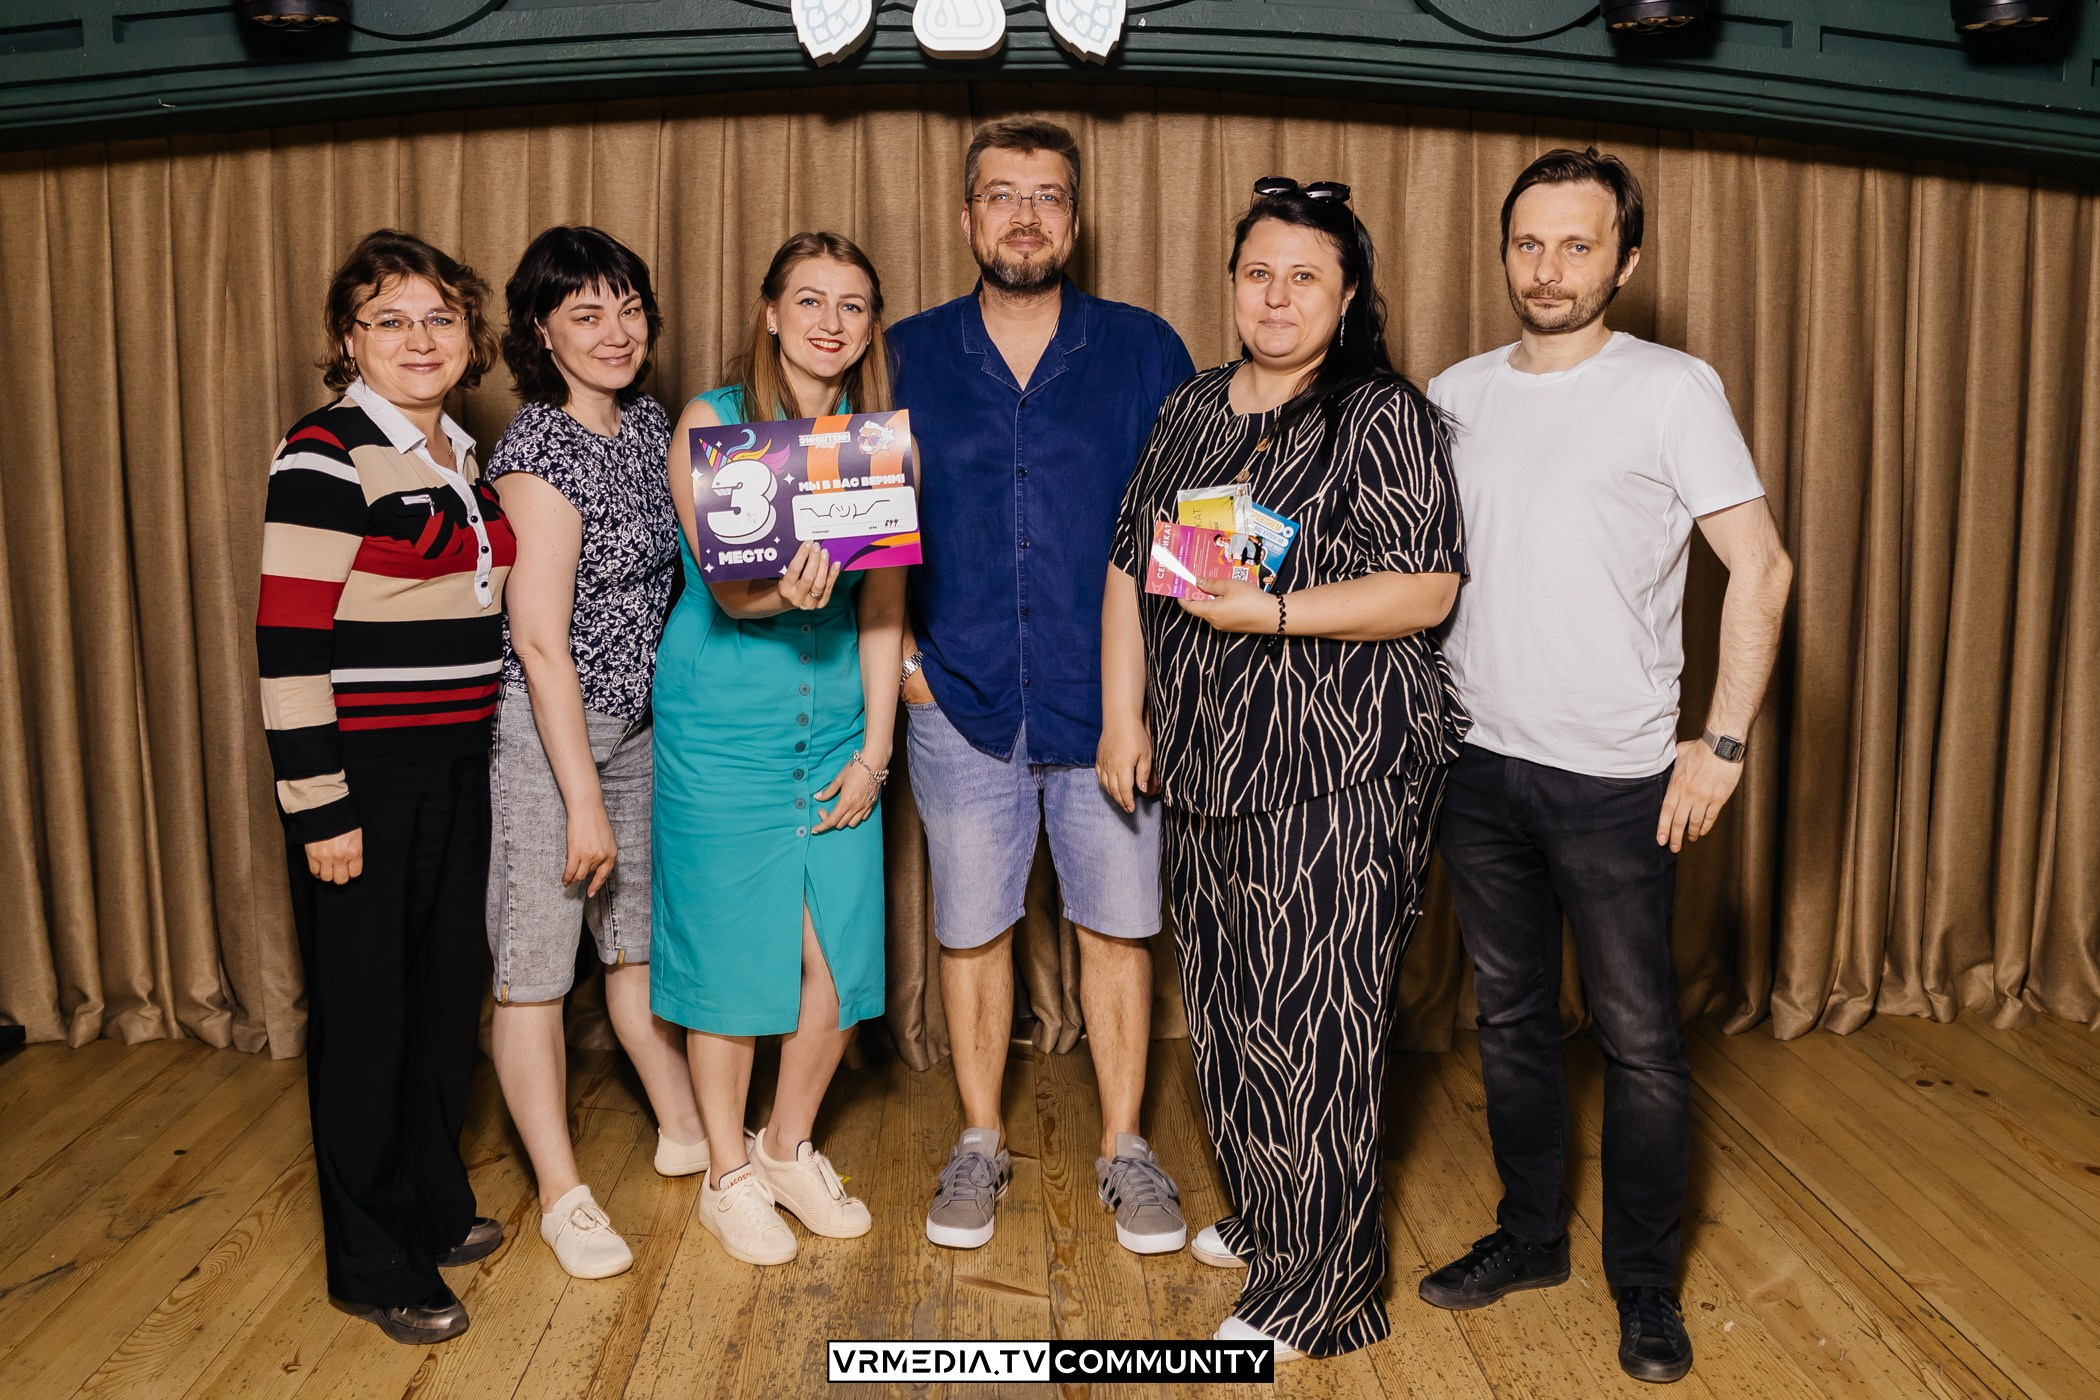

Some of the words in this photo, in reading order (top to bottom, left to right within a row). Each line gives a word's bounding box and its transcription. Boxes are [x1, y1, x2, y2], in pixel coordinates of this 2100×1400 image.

[798, 481, 821, 492] МЫ
[822, 480, 831, 490] В
[833, 477, 860, 489] ВАС
[860, 473, 906, 487] ВЕРИМ!
[707, 458, 778, 545] 3
[718, 546, 778, 566] МЕСТО
